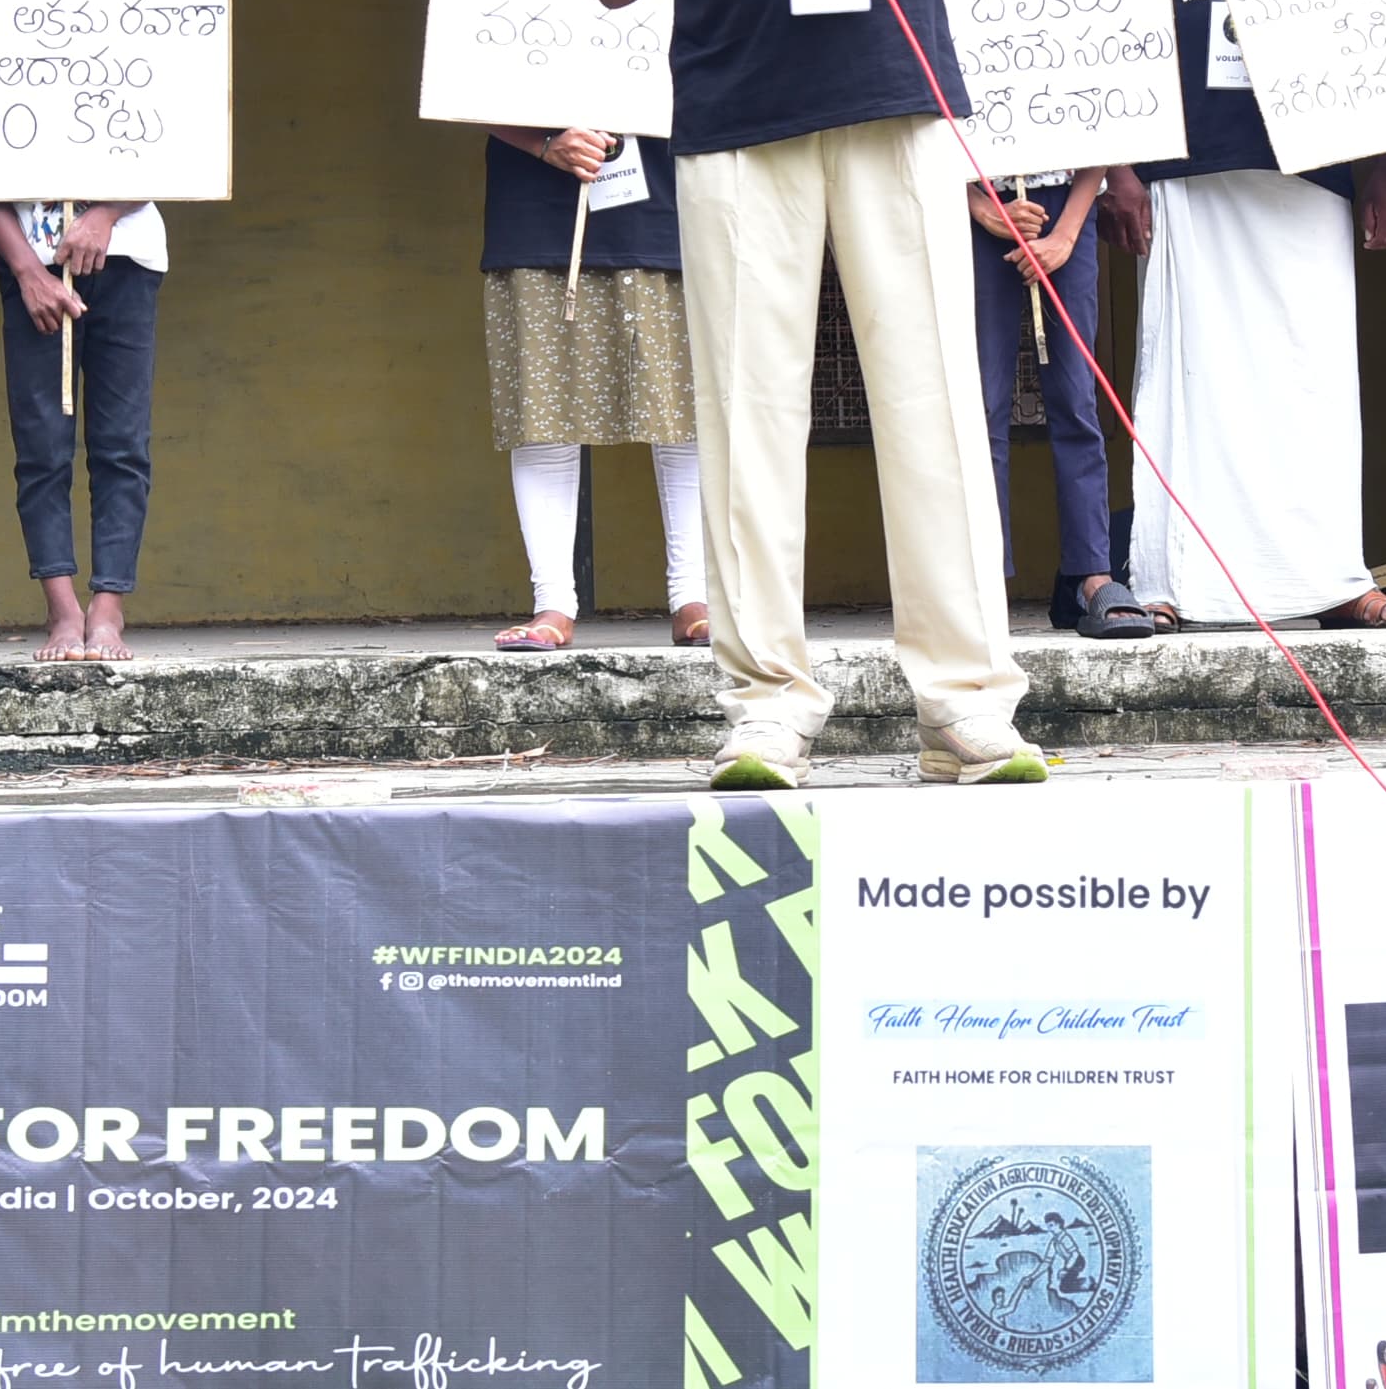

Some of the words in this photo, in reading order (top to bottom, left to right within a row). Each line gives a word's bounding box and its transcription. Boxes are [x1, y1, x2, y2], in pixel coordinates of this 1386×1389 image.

[1074, 18, 1174, 66] సంతలు
[67, 89, 164, 158] కోట్లు
[1028, 84, 1158, 132] ఉన్నాయి
[857, 877, 971, 909] Made
[983, 876, 1150, 918] possible
[1162, 878, 1211, 919] by
[372, 946, 623, 966] #WFFINDIA2024
[427, 972, 623, 990] @themovementind
[868, 1004, 923, 1032] Faith
[933, 1004, 1000, 1033] Home
[997, 1007, 1033, 1039] for
[1036, 1006, 1126, 1034] Children
[1132, 1006, 1191, 1033] Trust
[893, 1070, 940, 1085] FAITH
[945, 1070, 995, 1085] HOME
[999, 1070, 1032, 1085] FOR
[1036, 1070, 1119, 1085] CHILDREN
[1123, 1070, 1176, 1085] TRUST
[166, 1106, 606, 1163] FREEDOM
[87, 1186, 243, 1213] October,
[253, 1186, 339, 1210] 2024
[943, 1178, 999, 1246] EDUCATION
[97, 1346, 143, 1389] of
[159, 1338, 335, 1375] human
[332, 1332, 603, 1389] trafficking
[1007, 1335, 1065, 1354] RHEADS
